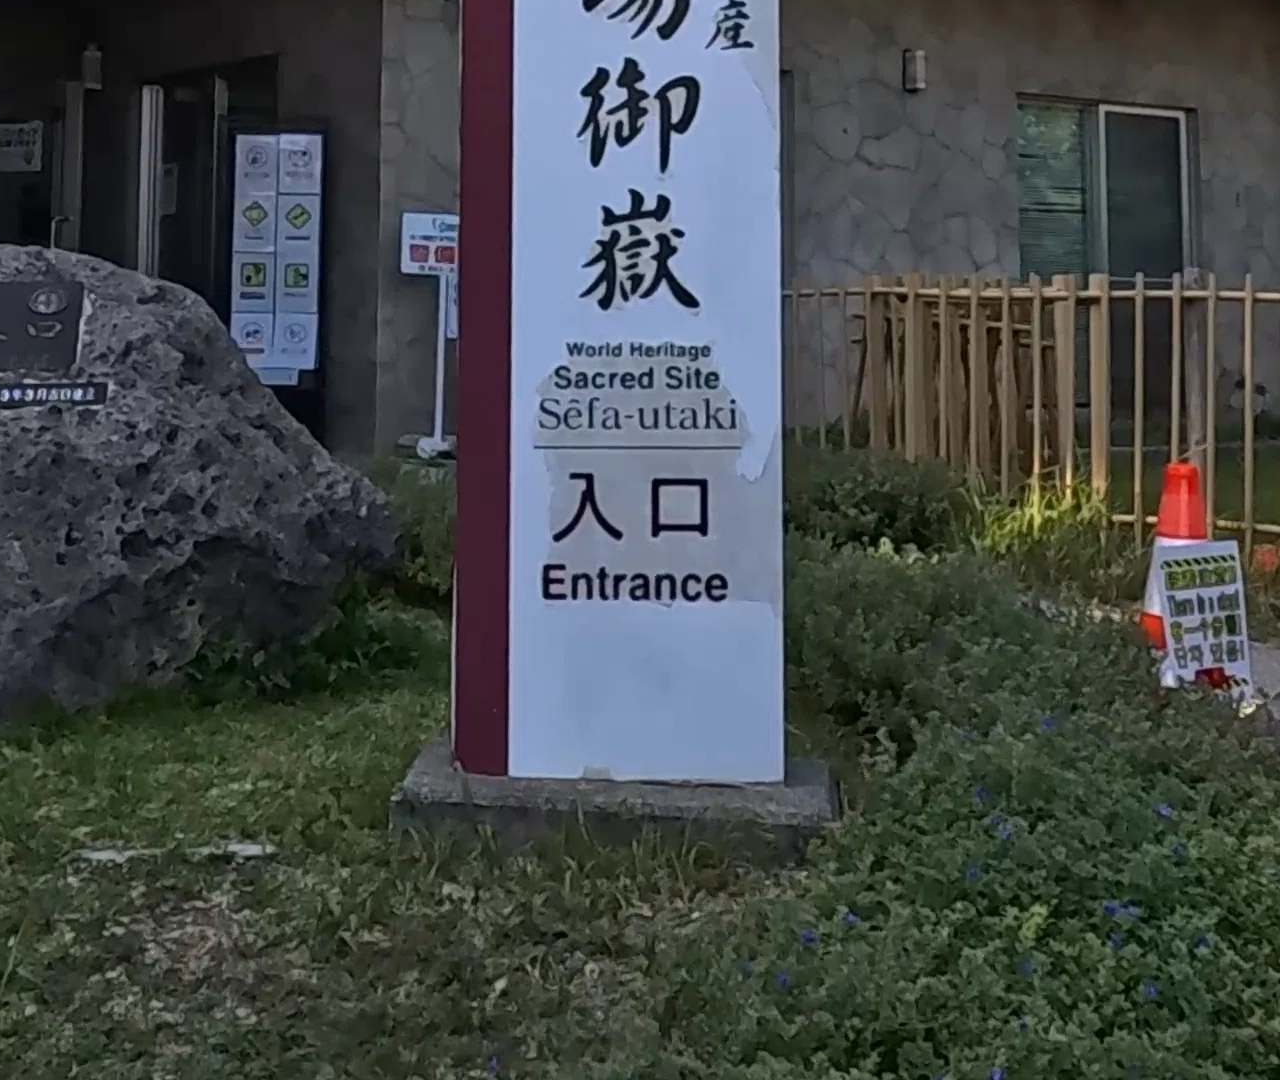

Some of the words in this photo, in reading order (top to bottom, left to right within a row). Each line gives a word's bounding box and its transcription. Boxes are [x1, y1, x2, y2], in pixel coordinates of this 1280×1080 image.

[566, 341, 623, 359] World
[629, 341, 712, 362] Heritage
[553, 365, 655, 390] Sacred
[665, 365, 721, 390] Site
[552, 472, 709, 543] 入口
[541, 563, 730, 602] Entrance
